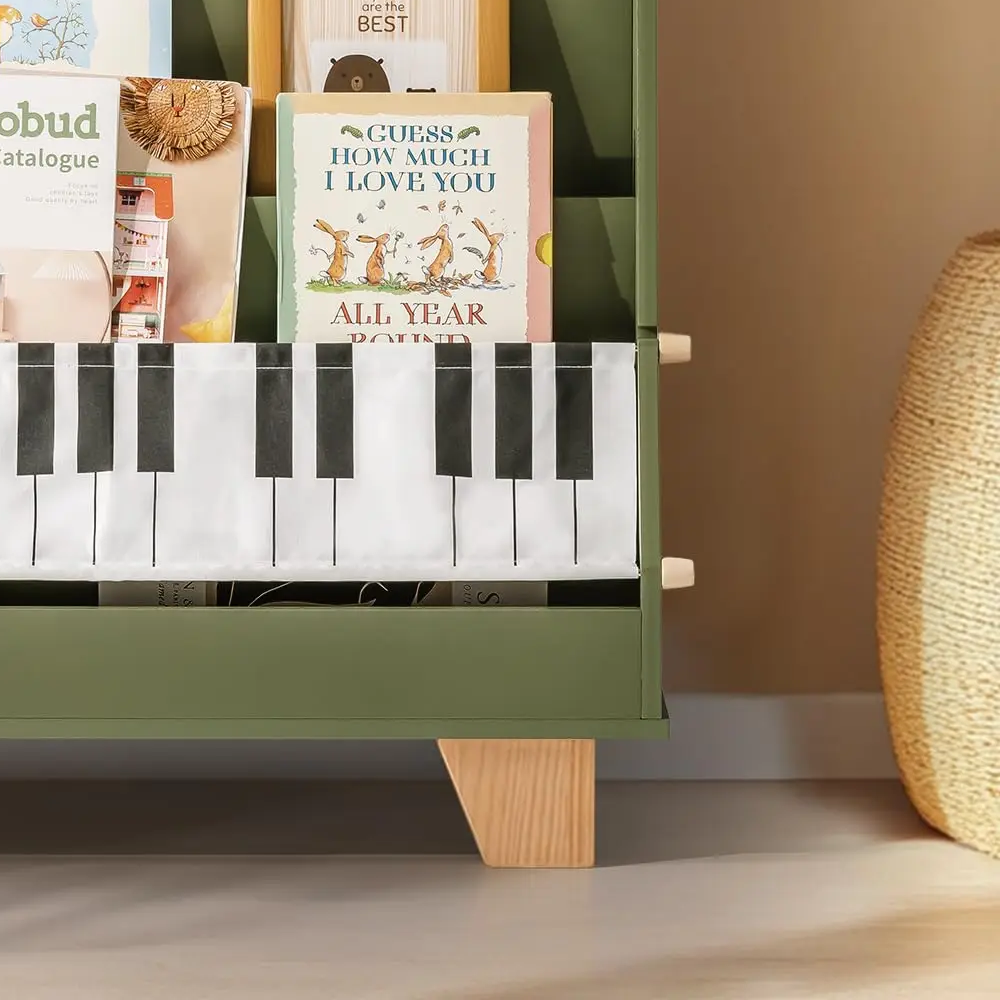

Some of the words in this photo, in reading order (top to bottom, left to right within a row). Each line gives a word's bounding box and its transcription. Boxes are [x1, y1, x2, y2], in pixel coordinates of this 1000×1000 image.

[362, 3, 382, 12] are
[385, 1, 405, 12] the
[358, 15, 408, 32] BEST
[367, 124, 454, 143] GUESS
[330, 147, 397, 166] HOW
[405, 148, 492, 167] MUCH
[324, 170, 334, 191] I
[345, 171, 425, 192] LOVE
[432, 171, 497, 193] YOU
[330, 301, 391, 326] ALL
[400, 302, 487, 326] YEAR
